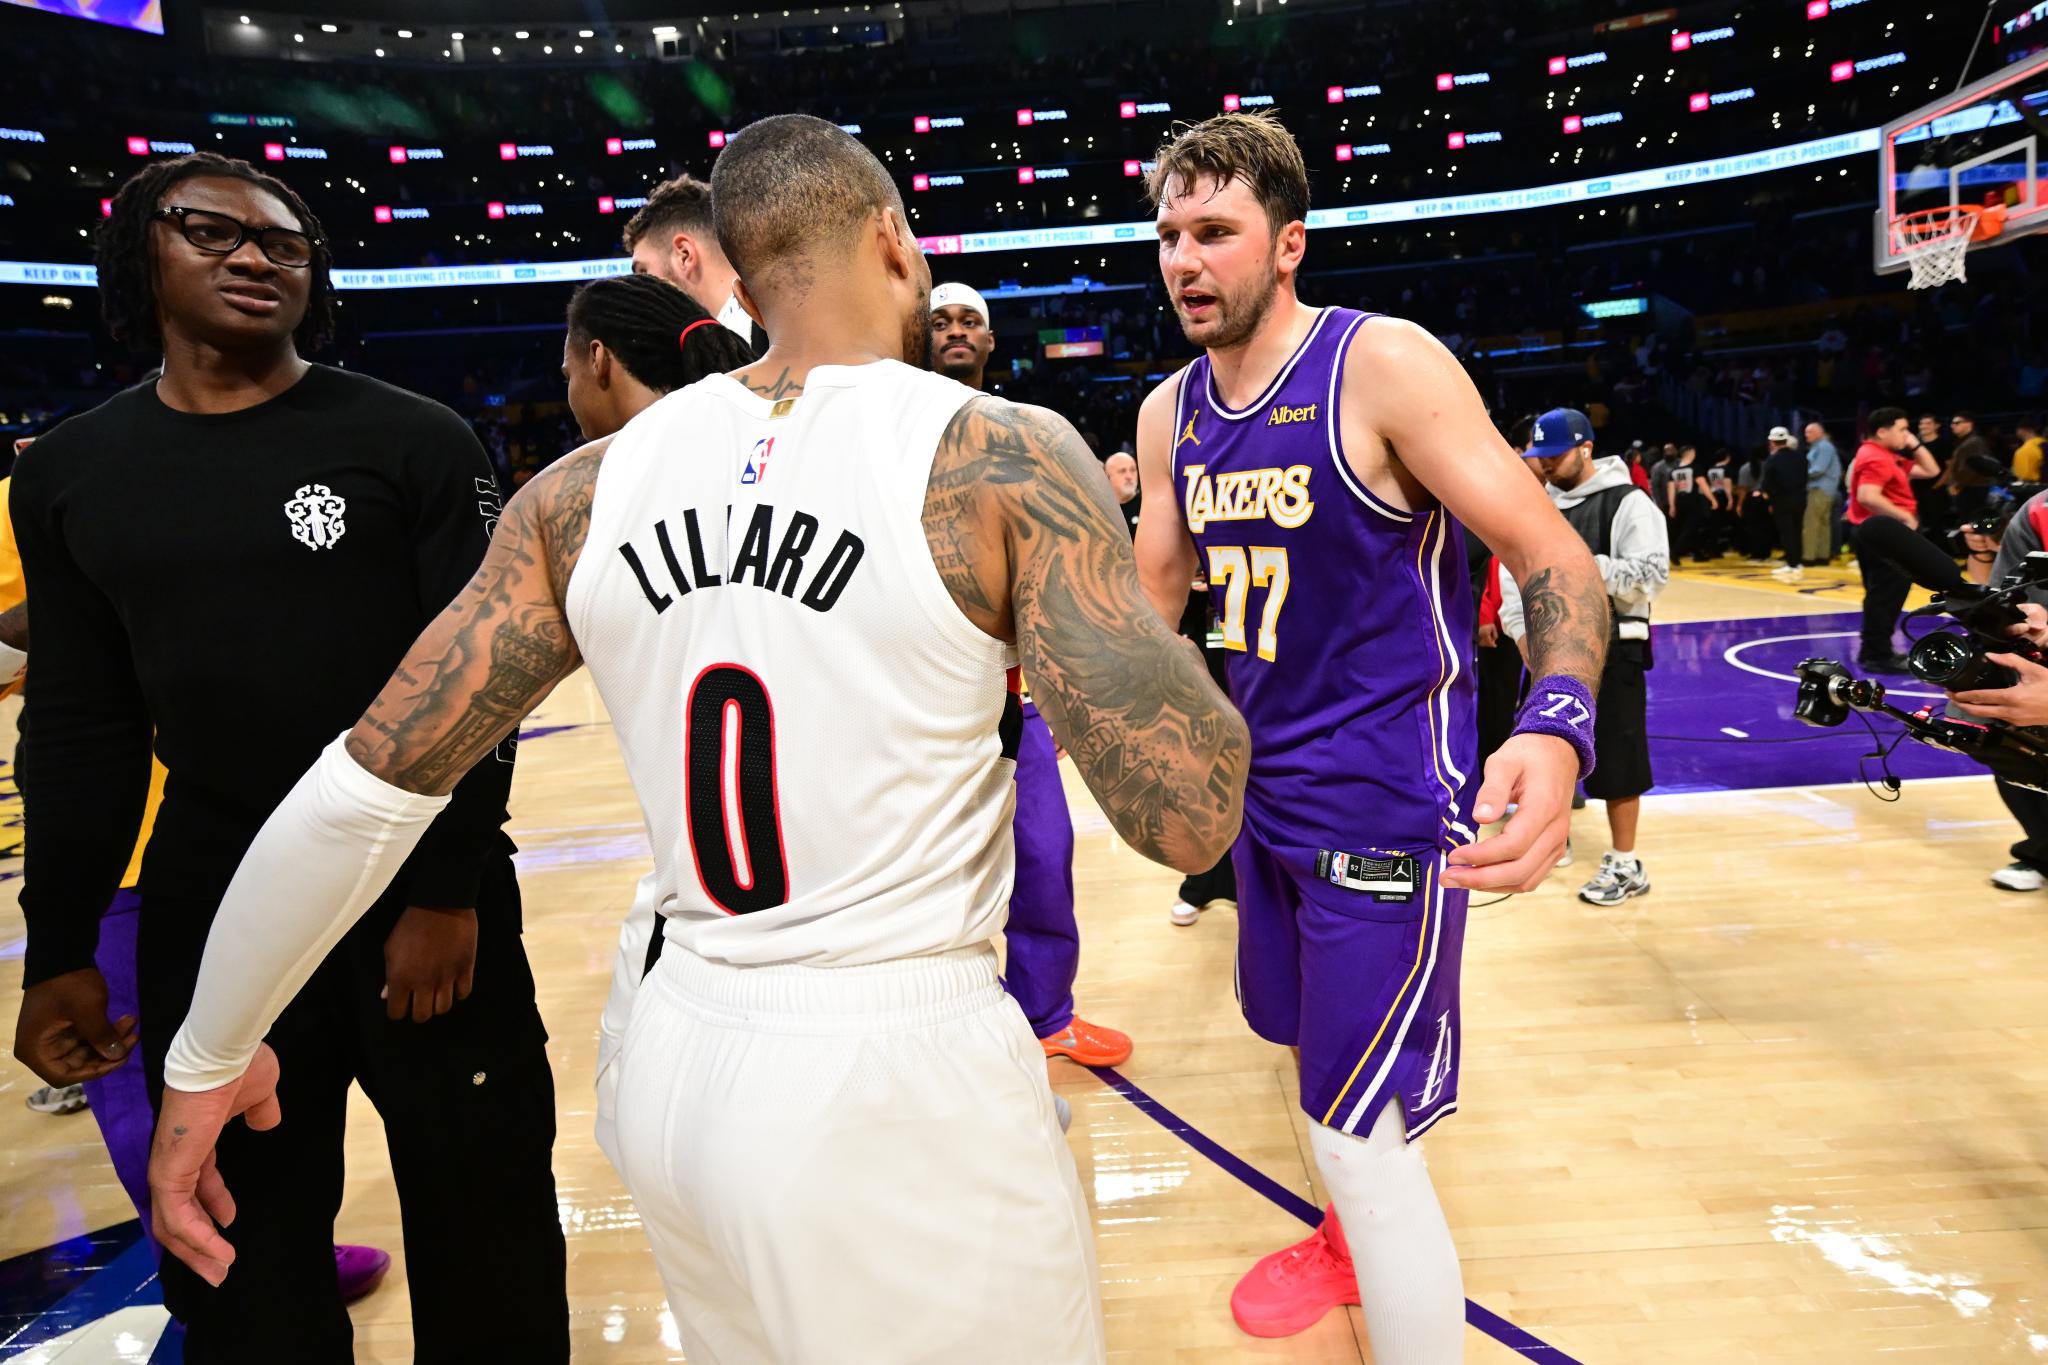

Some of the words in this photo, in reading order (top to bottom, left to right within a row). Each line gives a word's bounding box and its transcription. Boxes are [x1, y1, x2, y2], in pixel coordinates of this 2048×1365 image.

[0, 128, 45, 143] OYOTA
[1268, 403, 1317, 426] Albert
[1183, 464, 1314, 534] LAKERS
[618, 503, 866, 615] LILARD
[1206, 546, 1290, 663] 77
[1538, 692, 1590, 729] 77
[685, 662, 789, 917] 0
